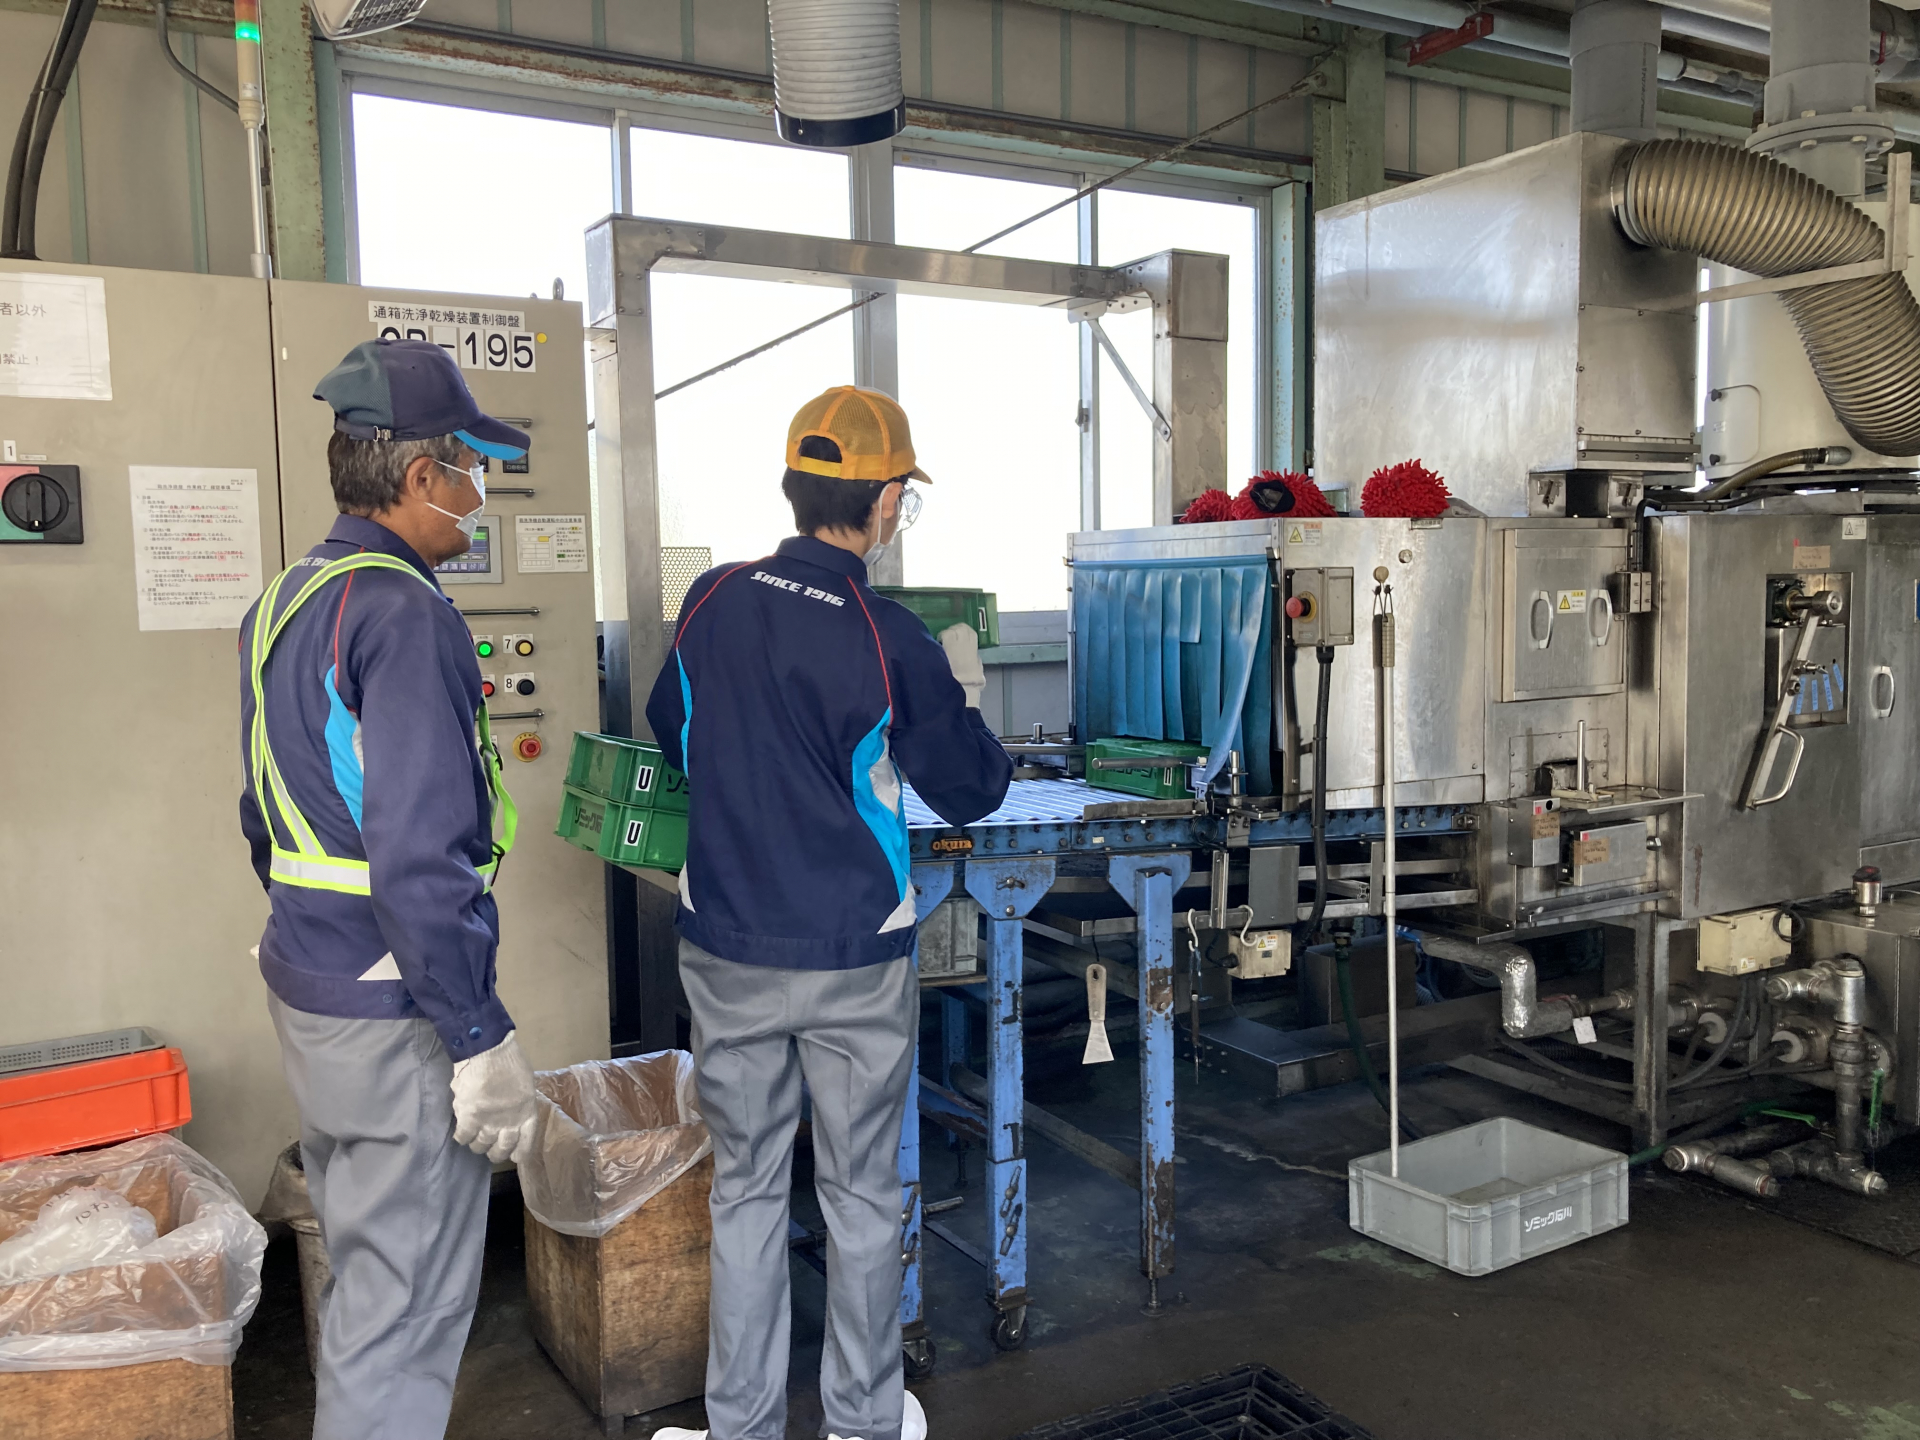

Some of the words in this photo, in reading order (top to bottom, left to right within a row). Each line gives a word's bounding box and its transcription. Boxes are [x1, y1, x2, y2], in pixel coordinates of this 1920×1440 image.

[373, 305, 521, 328] 通箱洗浄乾燥装置制御盤
[8, 446, 13, 456] 1
[750, 571, 803, 593] SINCE
[803, 586, 846, 607] 1916
[505, 639, 511, 650] 7
[506, 678, 512, 689] 8
[638, 767, 652, 790] U
[627, 822, 641, 844] U
[1524, 1206, 1572, 1232] ソミック石川
